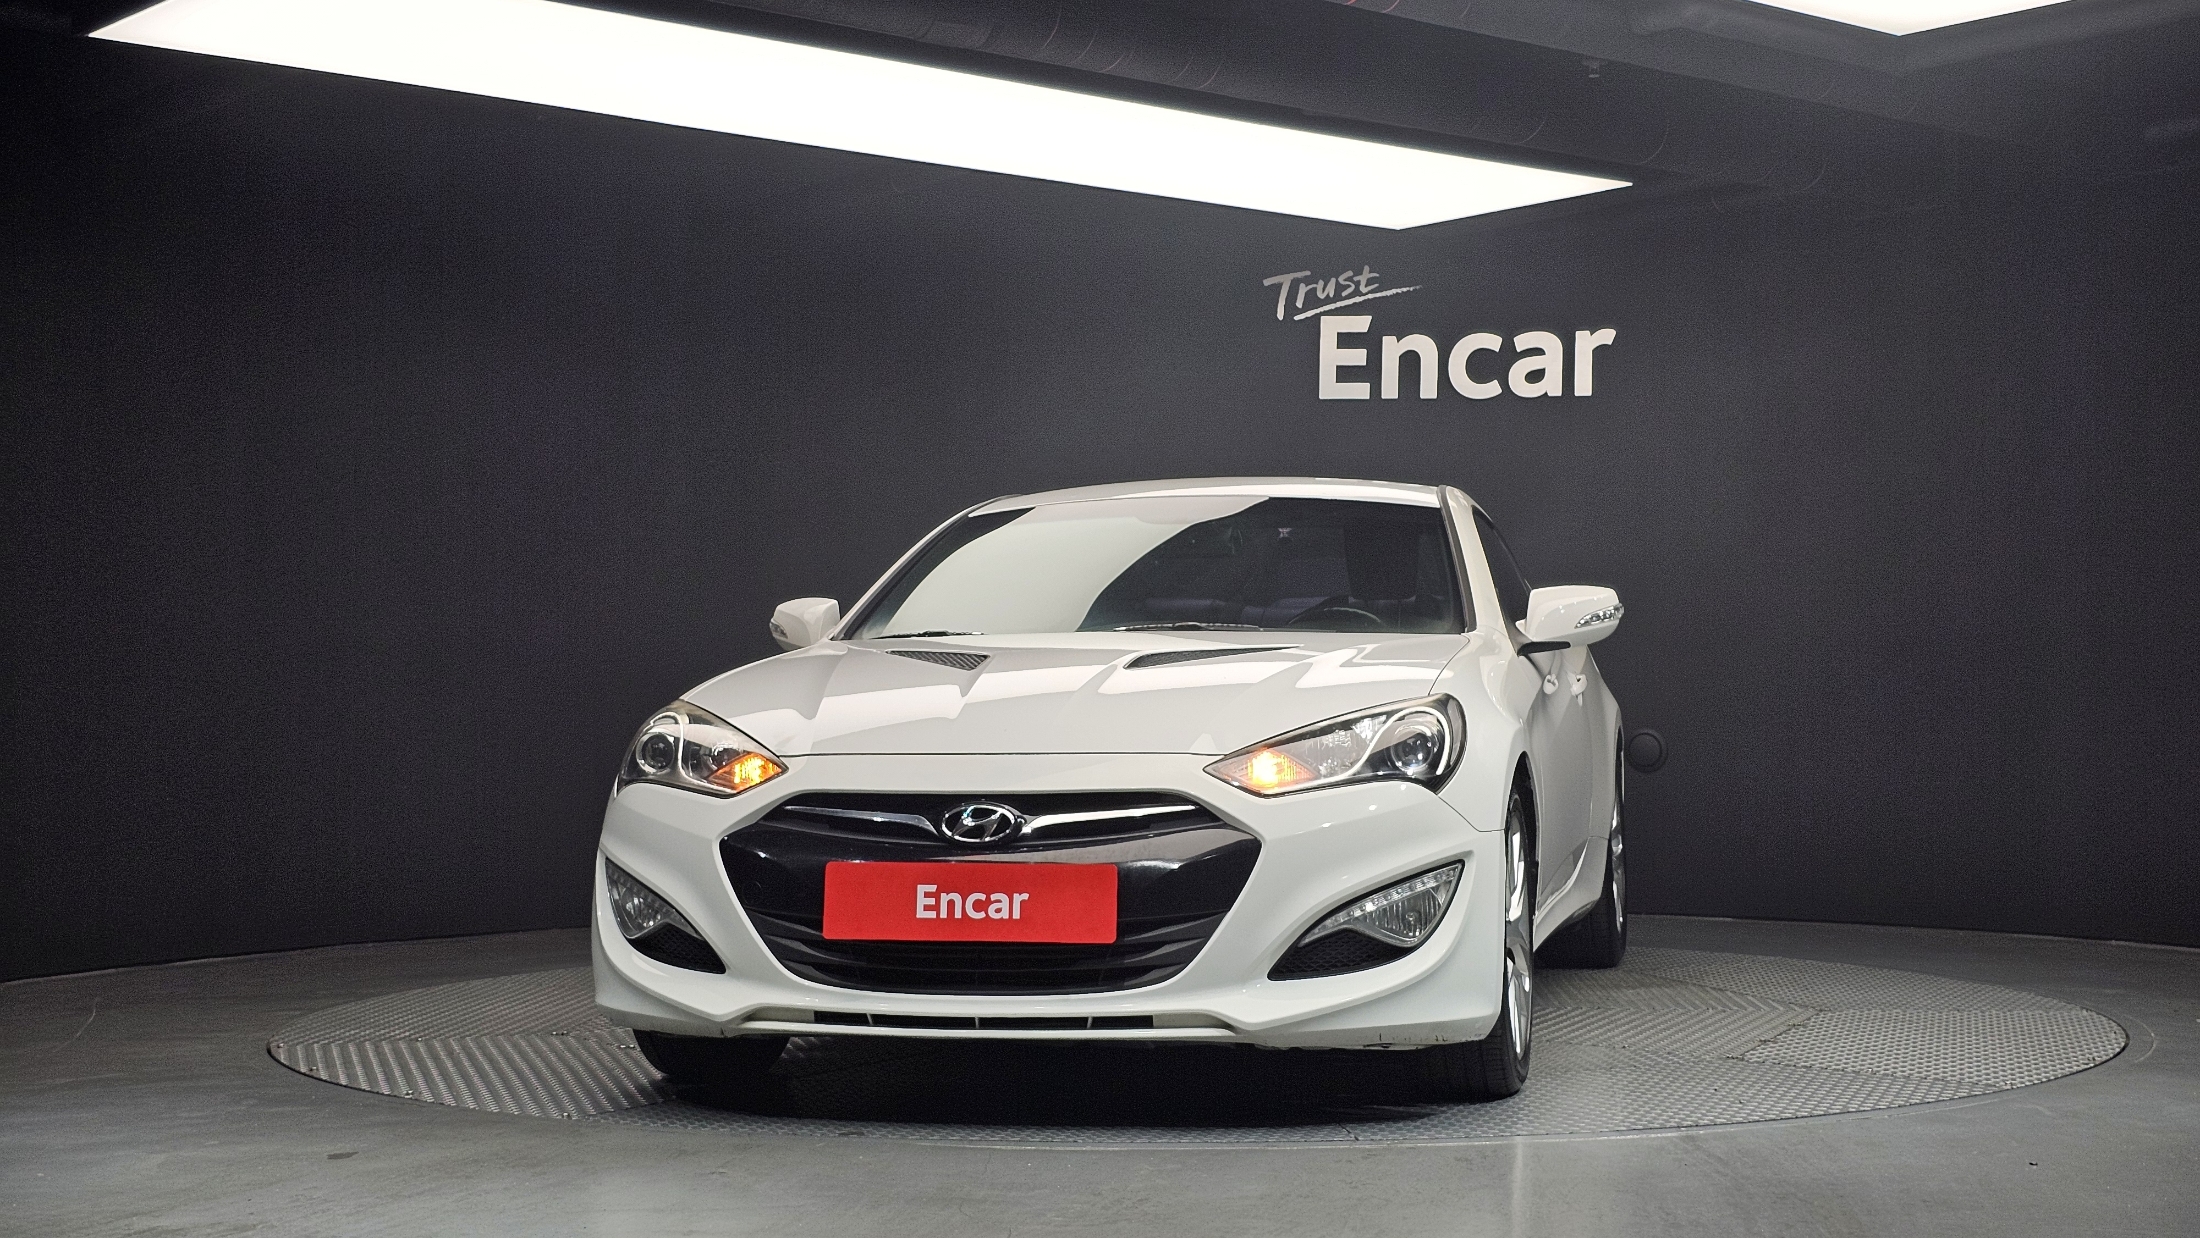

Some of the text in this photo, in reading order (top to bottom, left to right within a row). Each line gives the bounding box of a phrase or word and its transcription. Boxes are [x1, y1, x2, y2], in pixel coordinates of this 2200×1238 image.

[1263, 265, 1380, 321] Trust
[1318, 315, 1617, 400] Encar
[915, 884, 1030, 920] Encar
